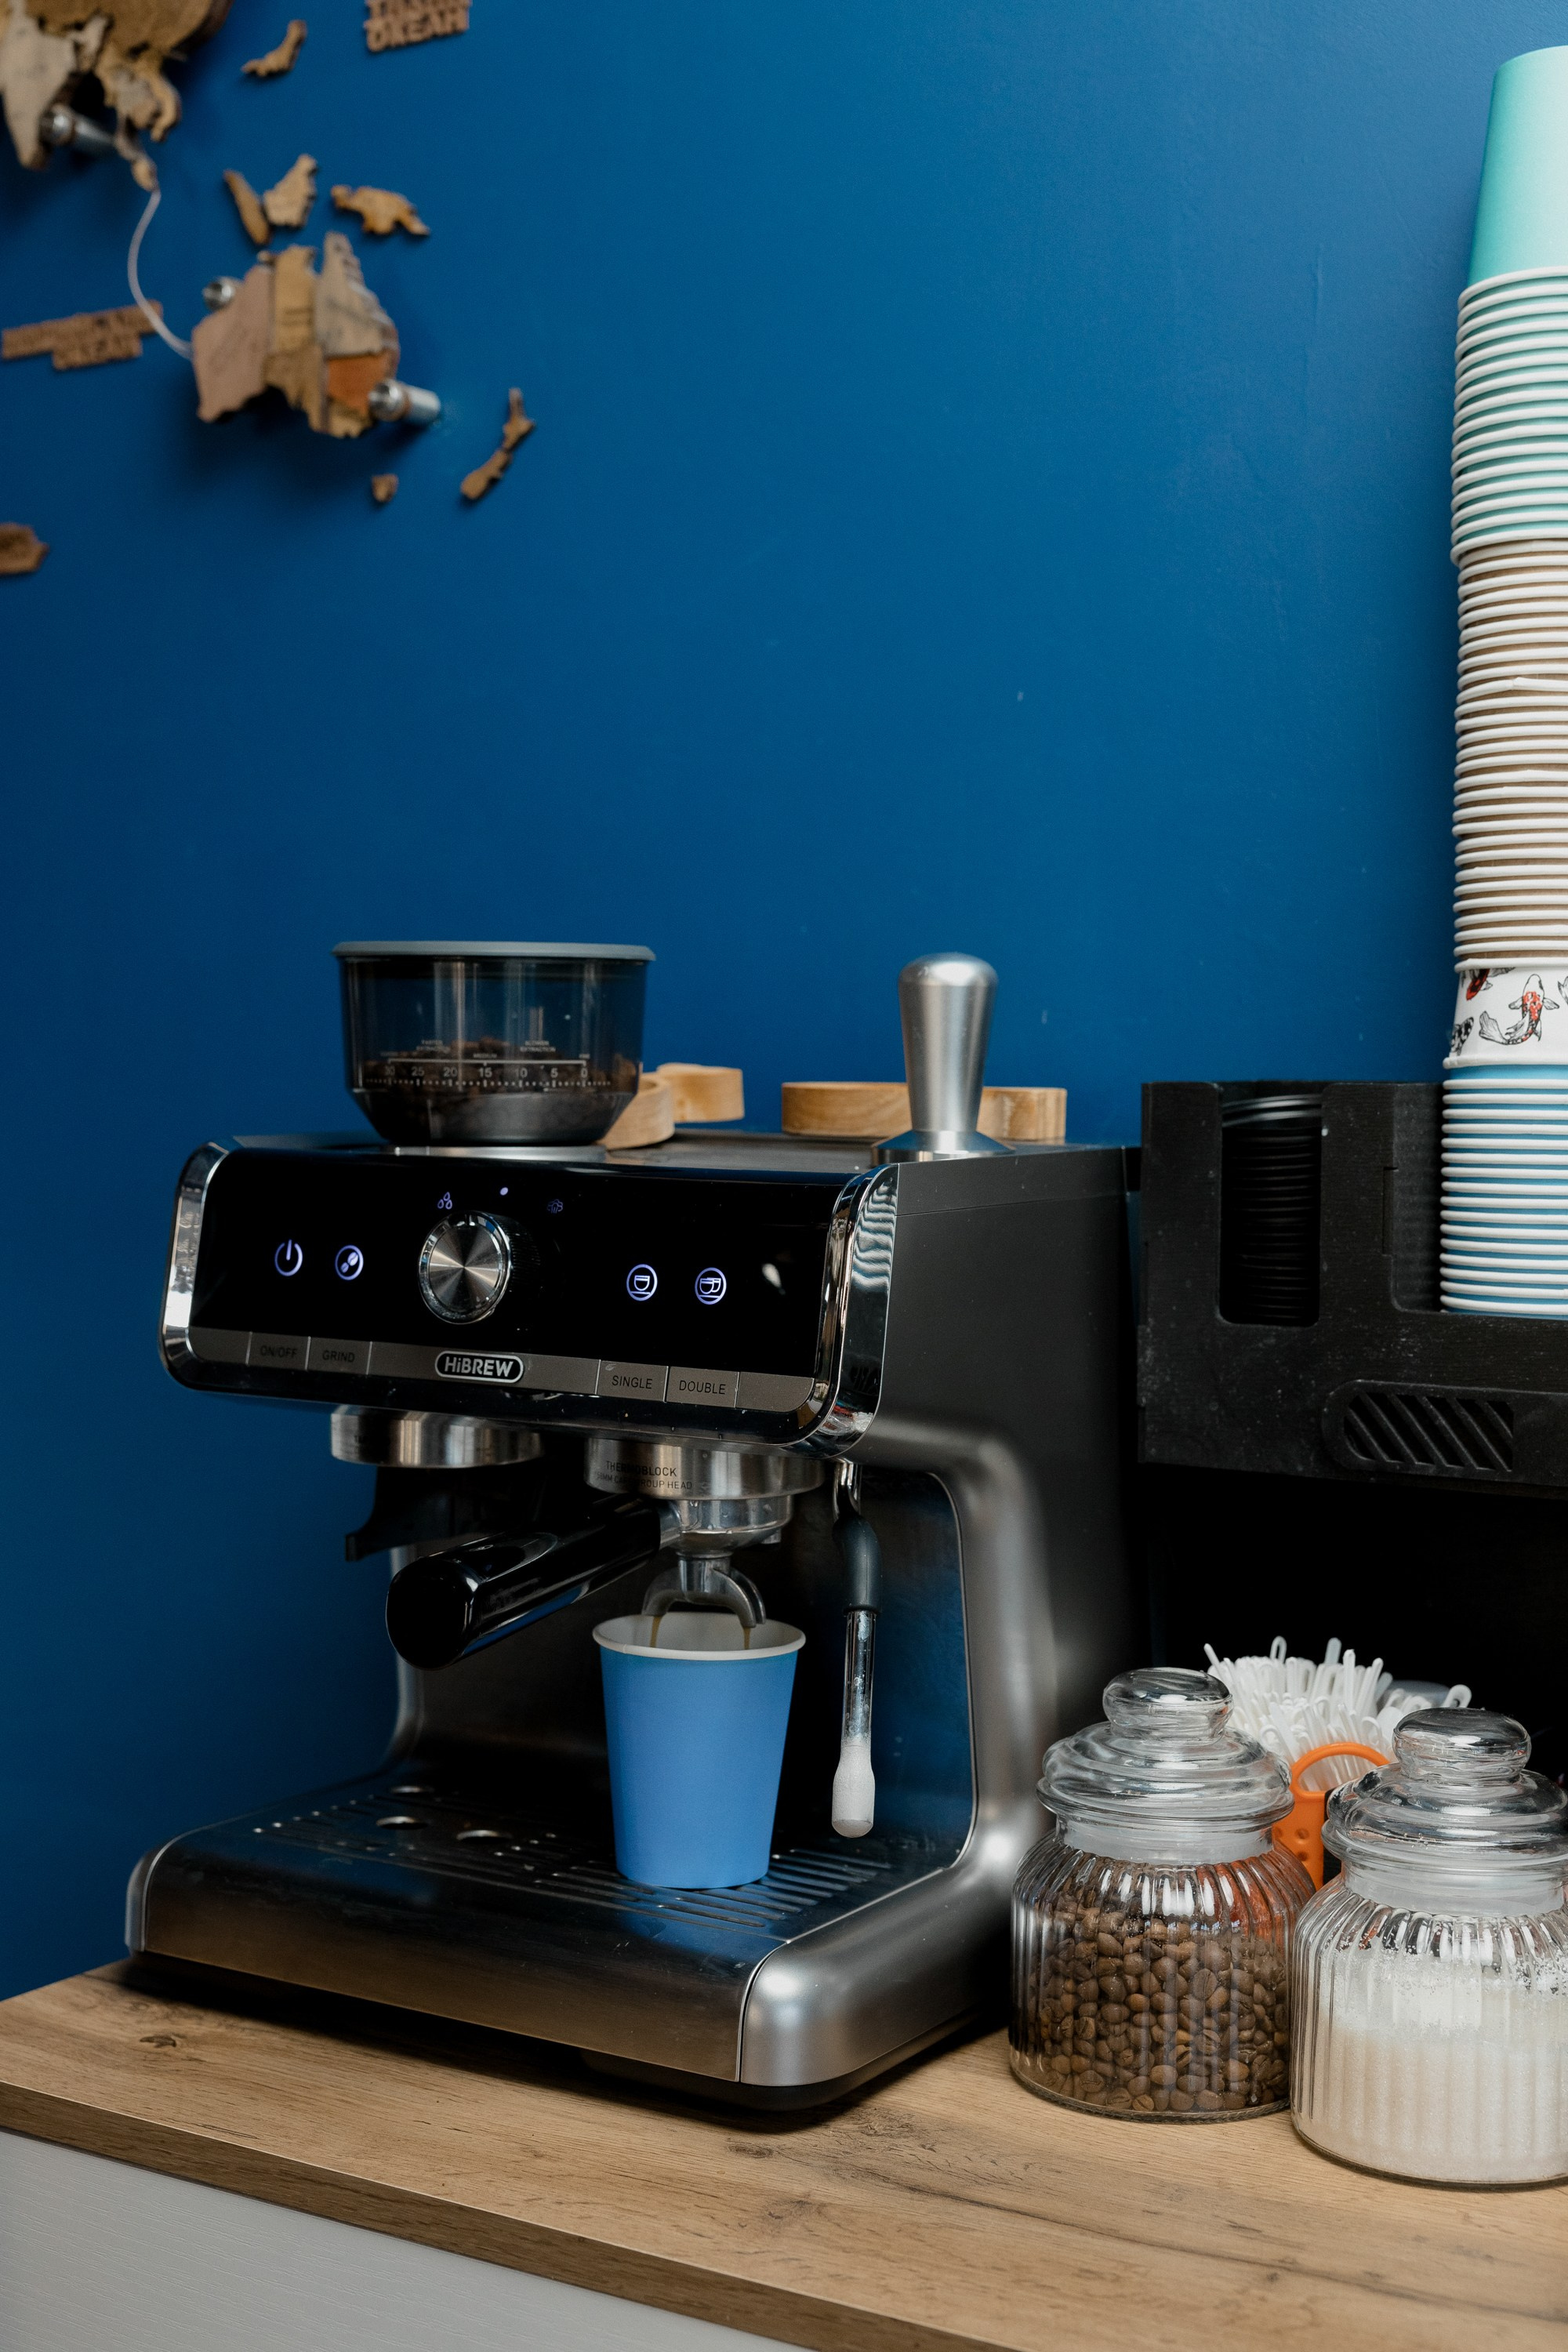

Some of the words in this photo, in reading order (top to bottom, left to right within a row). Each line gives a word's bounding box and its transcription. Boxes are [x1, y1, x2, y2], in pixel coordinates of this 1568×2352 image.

[412, 1066, 424, 1077] 25
[443, 1067, 458, 1078] 20
[478, 1067, 493, 1078] 15
[515, 1068, 528, 1078] 10
[550, 1068, 558, 1078] 5
[580, 1068, 588, 1078] 0
[322, 1350, 355, 1363] GRIND
[445, 1356, 514, 1377] HiBREW
[612, 1375, 652, 1389] SINGLE
[679, 1380, 725, 1395] DOUBLE
[634, 1478, 665, 1489] ROUP
[667, 1481, 692, 1490] HEAD
